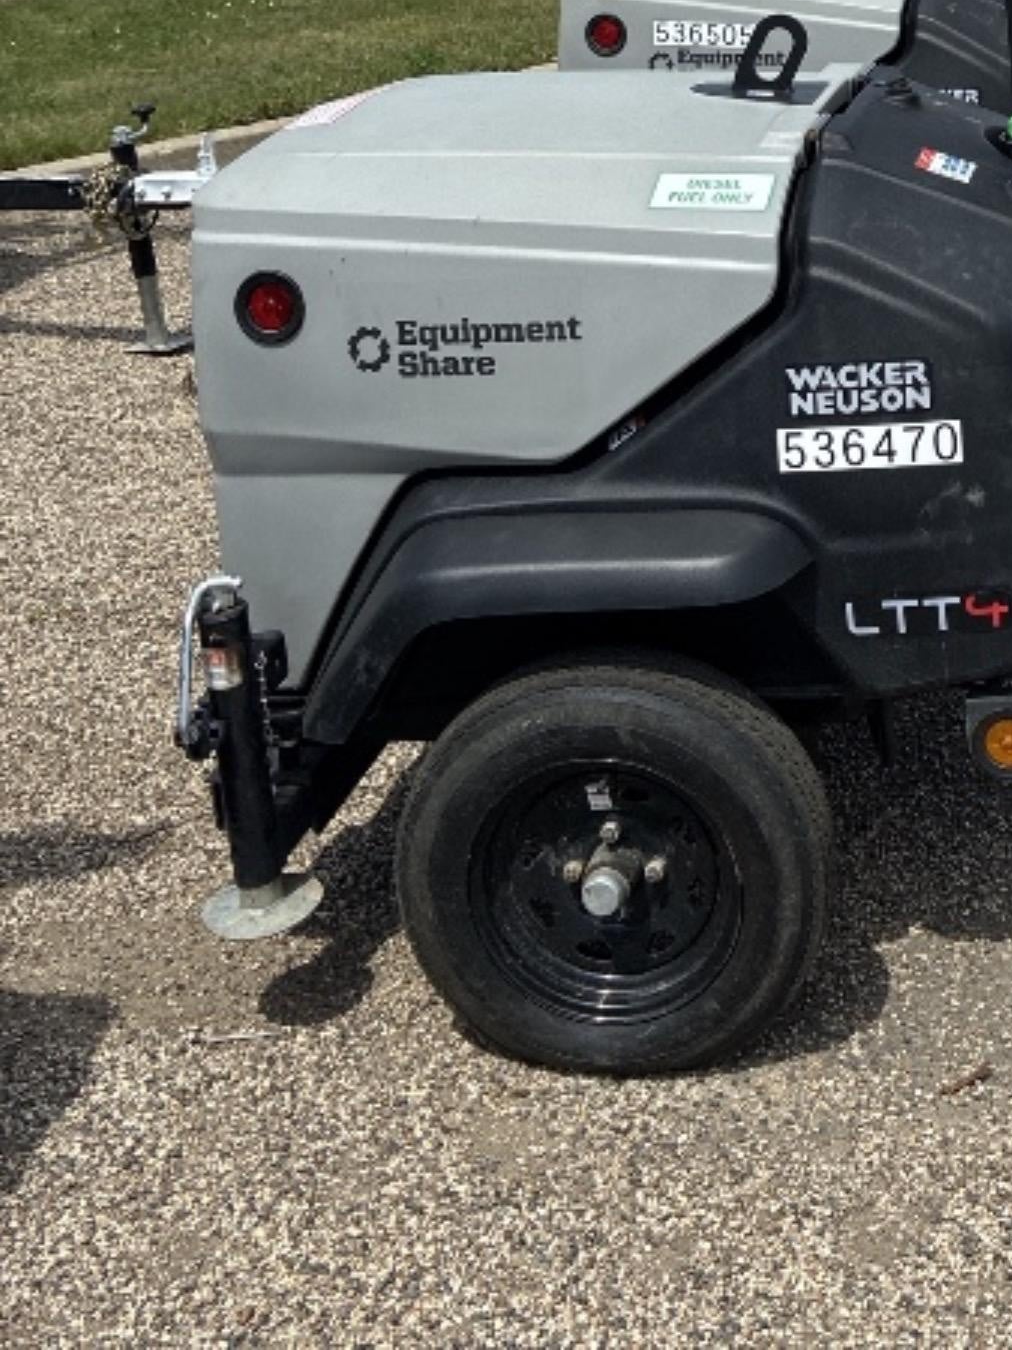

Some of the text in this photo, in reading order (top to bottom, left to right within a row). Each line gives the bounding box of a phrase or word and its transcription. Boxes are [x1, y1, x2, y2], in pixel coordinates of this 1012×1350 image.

[396, 316, 583, 352] Equipment
[398, 350, 496, 378] Share
[785, 361, 930, 391] WACKER
[791, 386, 932, 417] NEUSON
[784, 423, 958, 469] 536470
[845, 594, 1009, 636] LTT4
